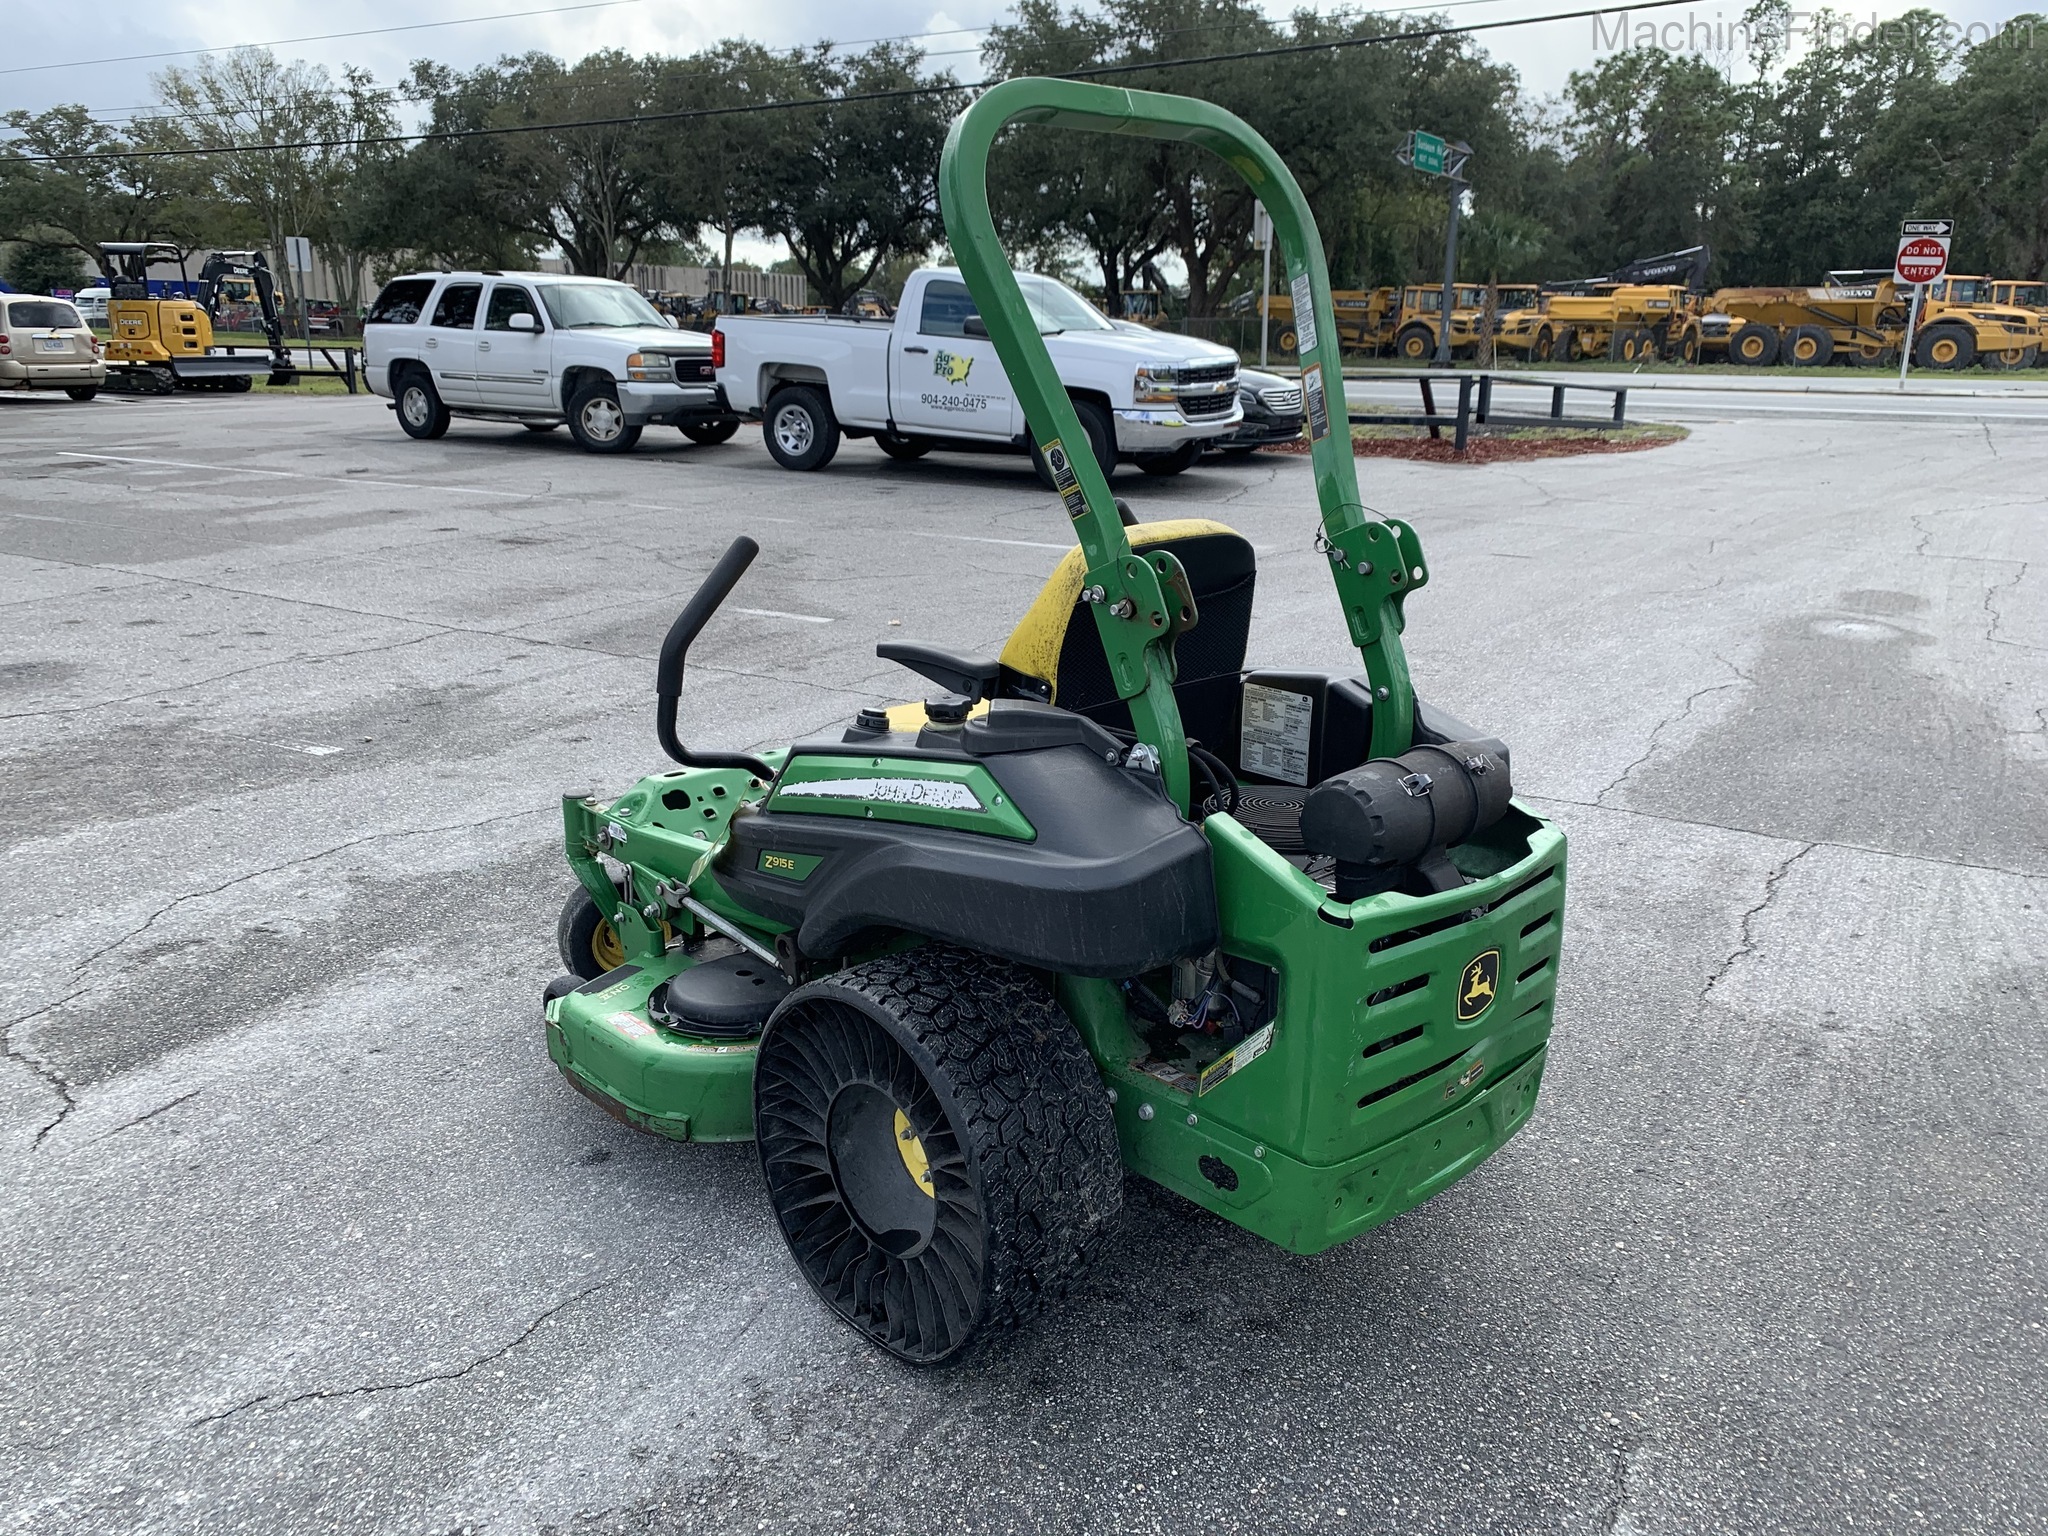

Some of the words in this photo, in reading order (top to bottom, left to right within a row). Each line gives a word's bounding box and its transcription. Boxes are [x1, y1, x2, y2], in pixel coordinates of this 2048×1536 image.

[1906, 246, 1919, 255] DO
[1923, 246, 1943, 255] NOT
[1643, 264, 1677, 277] VOLVO
[1903, 266, 1937, 275] ENTER
[1835, 289, 1872, 297] VOLVO
[119, 318, 143, 326] DEERE
[933, 362, 954, 376] Pro
[921, 393, 987, 409] 904-240-0475
[764, 854, 795, 870] Z915E
